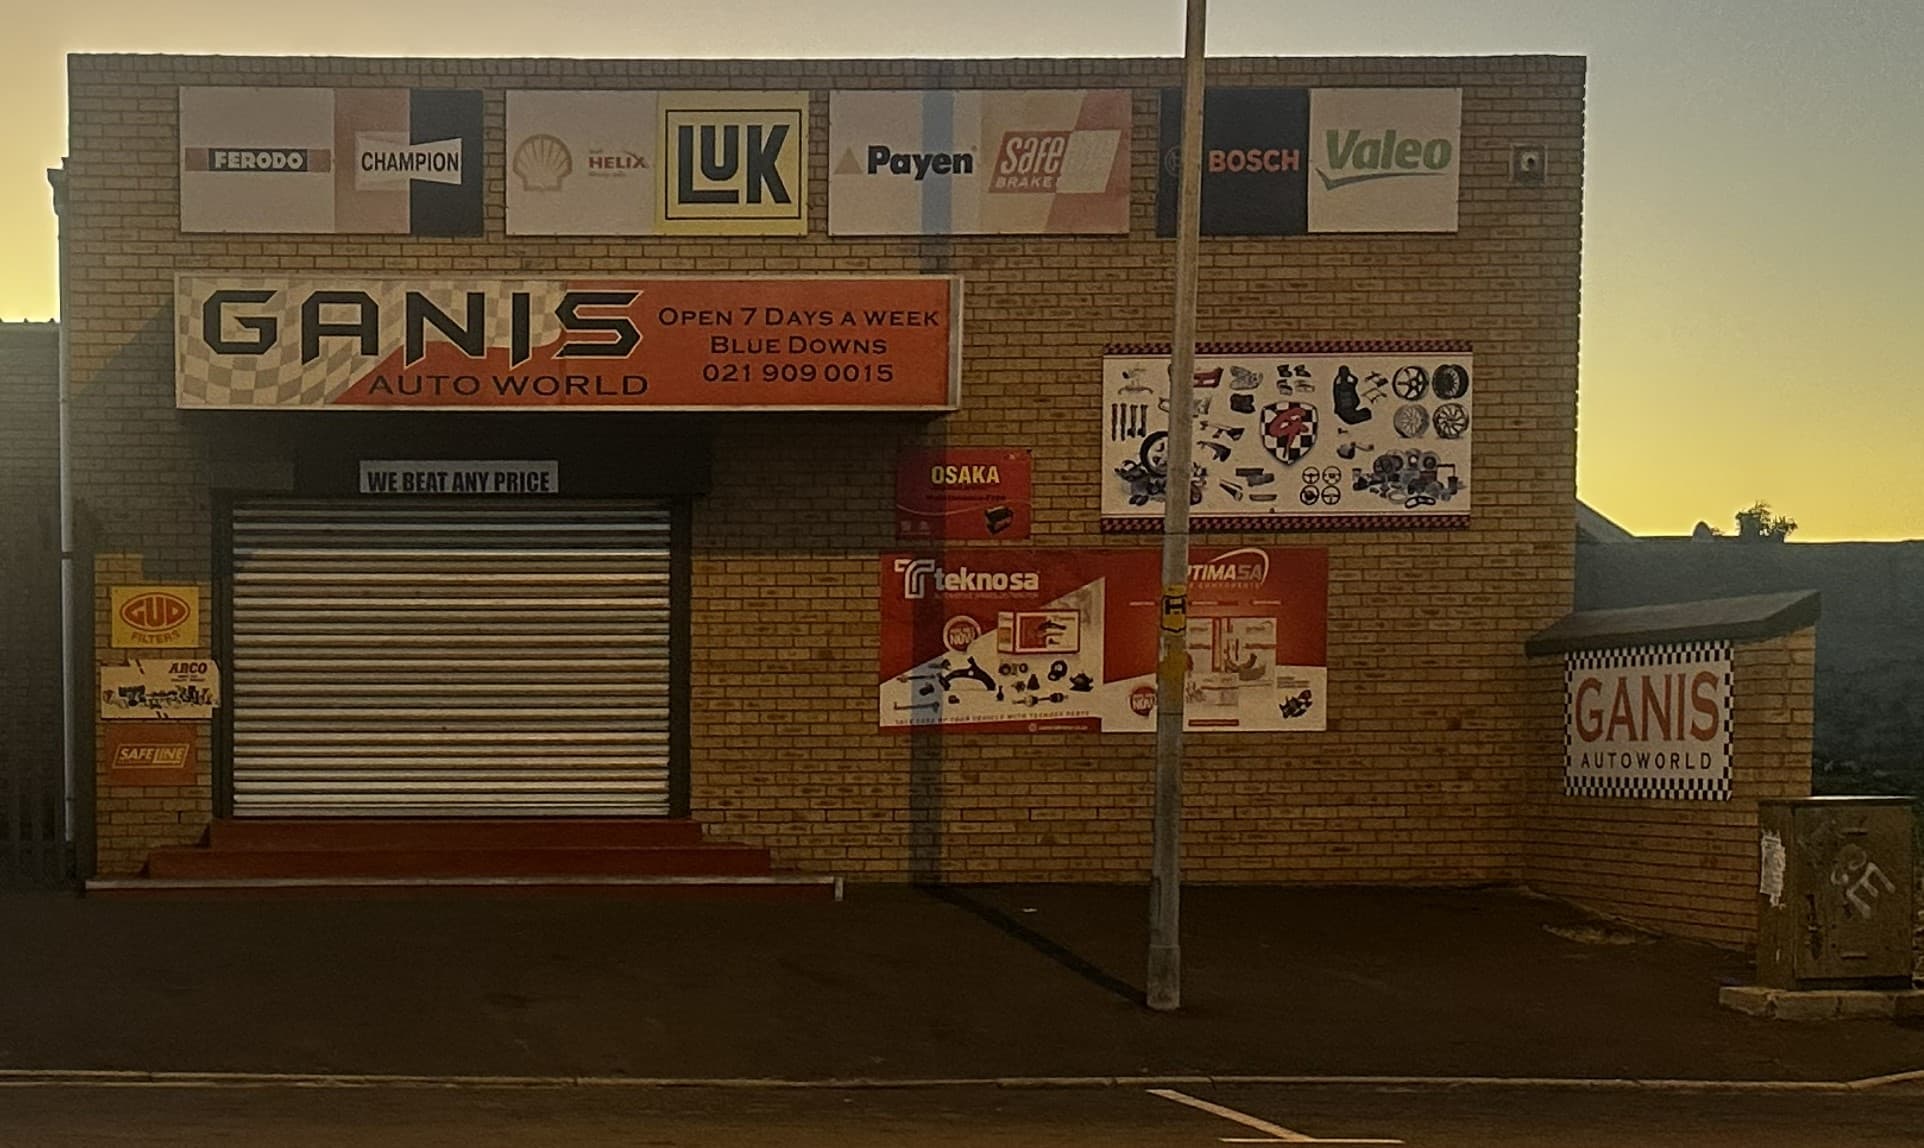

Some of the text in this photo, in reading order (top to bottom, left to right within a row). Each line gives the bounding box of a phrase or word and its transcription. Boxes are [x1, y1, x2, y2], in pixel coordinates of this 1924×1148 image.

[214, 150, 304, 169] FERODO
[361, 149, 459, 171] CHAMPION
[1325, 129, 1452, 170] Valeo
[588, 155, 650, 169] HELIX
[867, 145, 973, 181] Payen
[1208, 149, 1299, 173] BOSCH
[740, 307, 759, 326] 7
[840, 310, 856, 326] A
[864, 310, 940, 326] WEEK
[203, 289, 645, 370] GANIS
[703, 364, 894, 383] 021 909 0015
[368, 375, 649, 396] AUTO WORLD
[367, 471, 550, 493] WE BEAT ANY PRICE
[930, 465, 1001, 485] OSAKA
[934, 567, 1040, 591] teknosa
[1188, 564, 1263, 581] TIMASA
[123, 596, 188, 628] GUD
[130, 629, 182, 645] FILTERS
[1574, 670, 1720, 743] GANIS
[1581, 751, 1712, 770] AUTOWORLD
